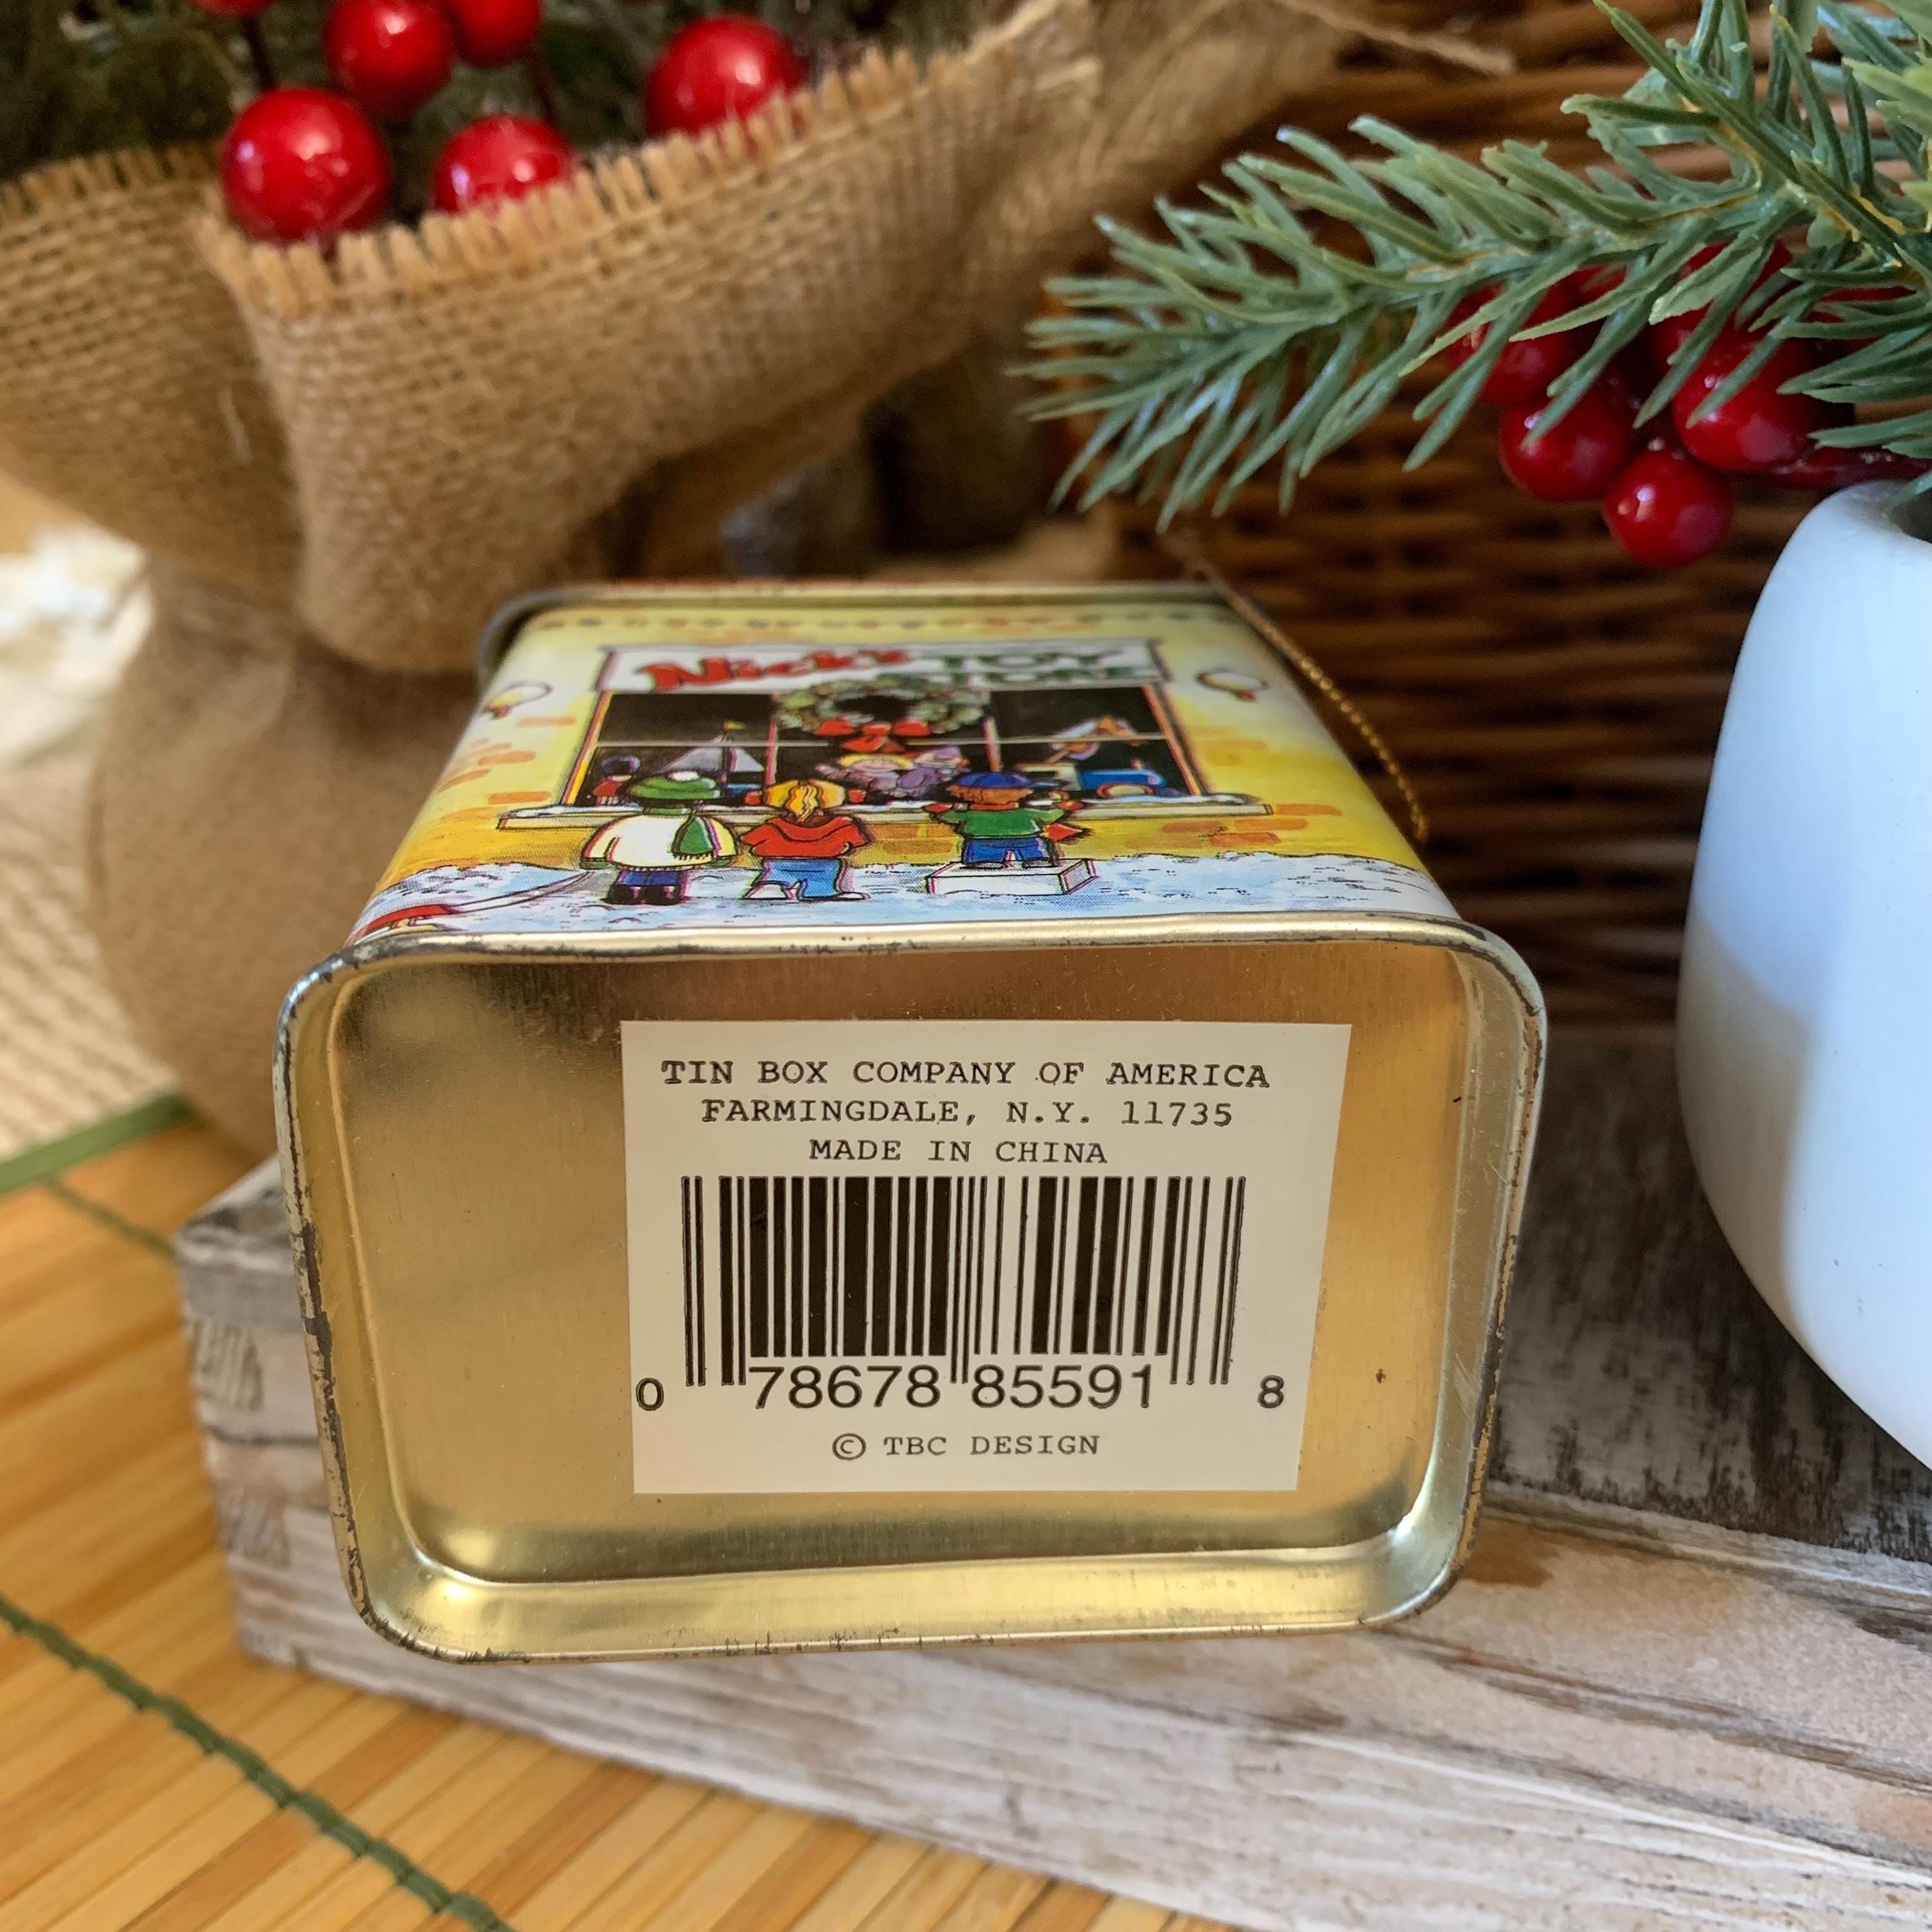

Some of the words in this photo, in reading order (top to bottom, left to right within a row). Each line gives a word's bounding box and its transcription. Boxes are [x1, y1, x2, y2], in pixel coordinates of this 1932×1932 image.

[661, 1060, 734, 1084] TIN
[757, 1060, 828, 1084] BOX
[853, 1061, 1016, 1085] COMPANY
[1039, 1061, 1084, 1086] OF
[1105, 1062, 1270, 1088] AMERICA
[701, 1099, 976, 1126] FARMINGDALE,
[1007, 1101, 1090, 1124] N.Y.
[1121, 1101, 1232, 1127] 11735
[809, 1139, 901, 1160] MADE
[928, 1141, 971, 1162] IN
[996, 1141, 1108, 1164] CHINA
[636, 1378, 665, 1412] 0
[750, 1365, 941, 1410] 78678
[971, 1365, 1151, 1409] 85591
[1257, 1375, 1284, 1409] 8
[884, 1436, 947, 1456] TBC
[971, 1435, 1099, 1455] DESIGN
